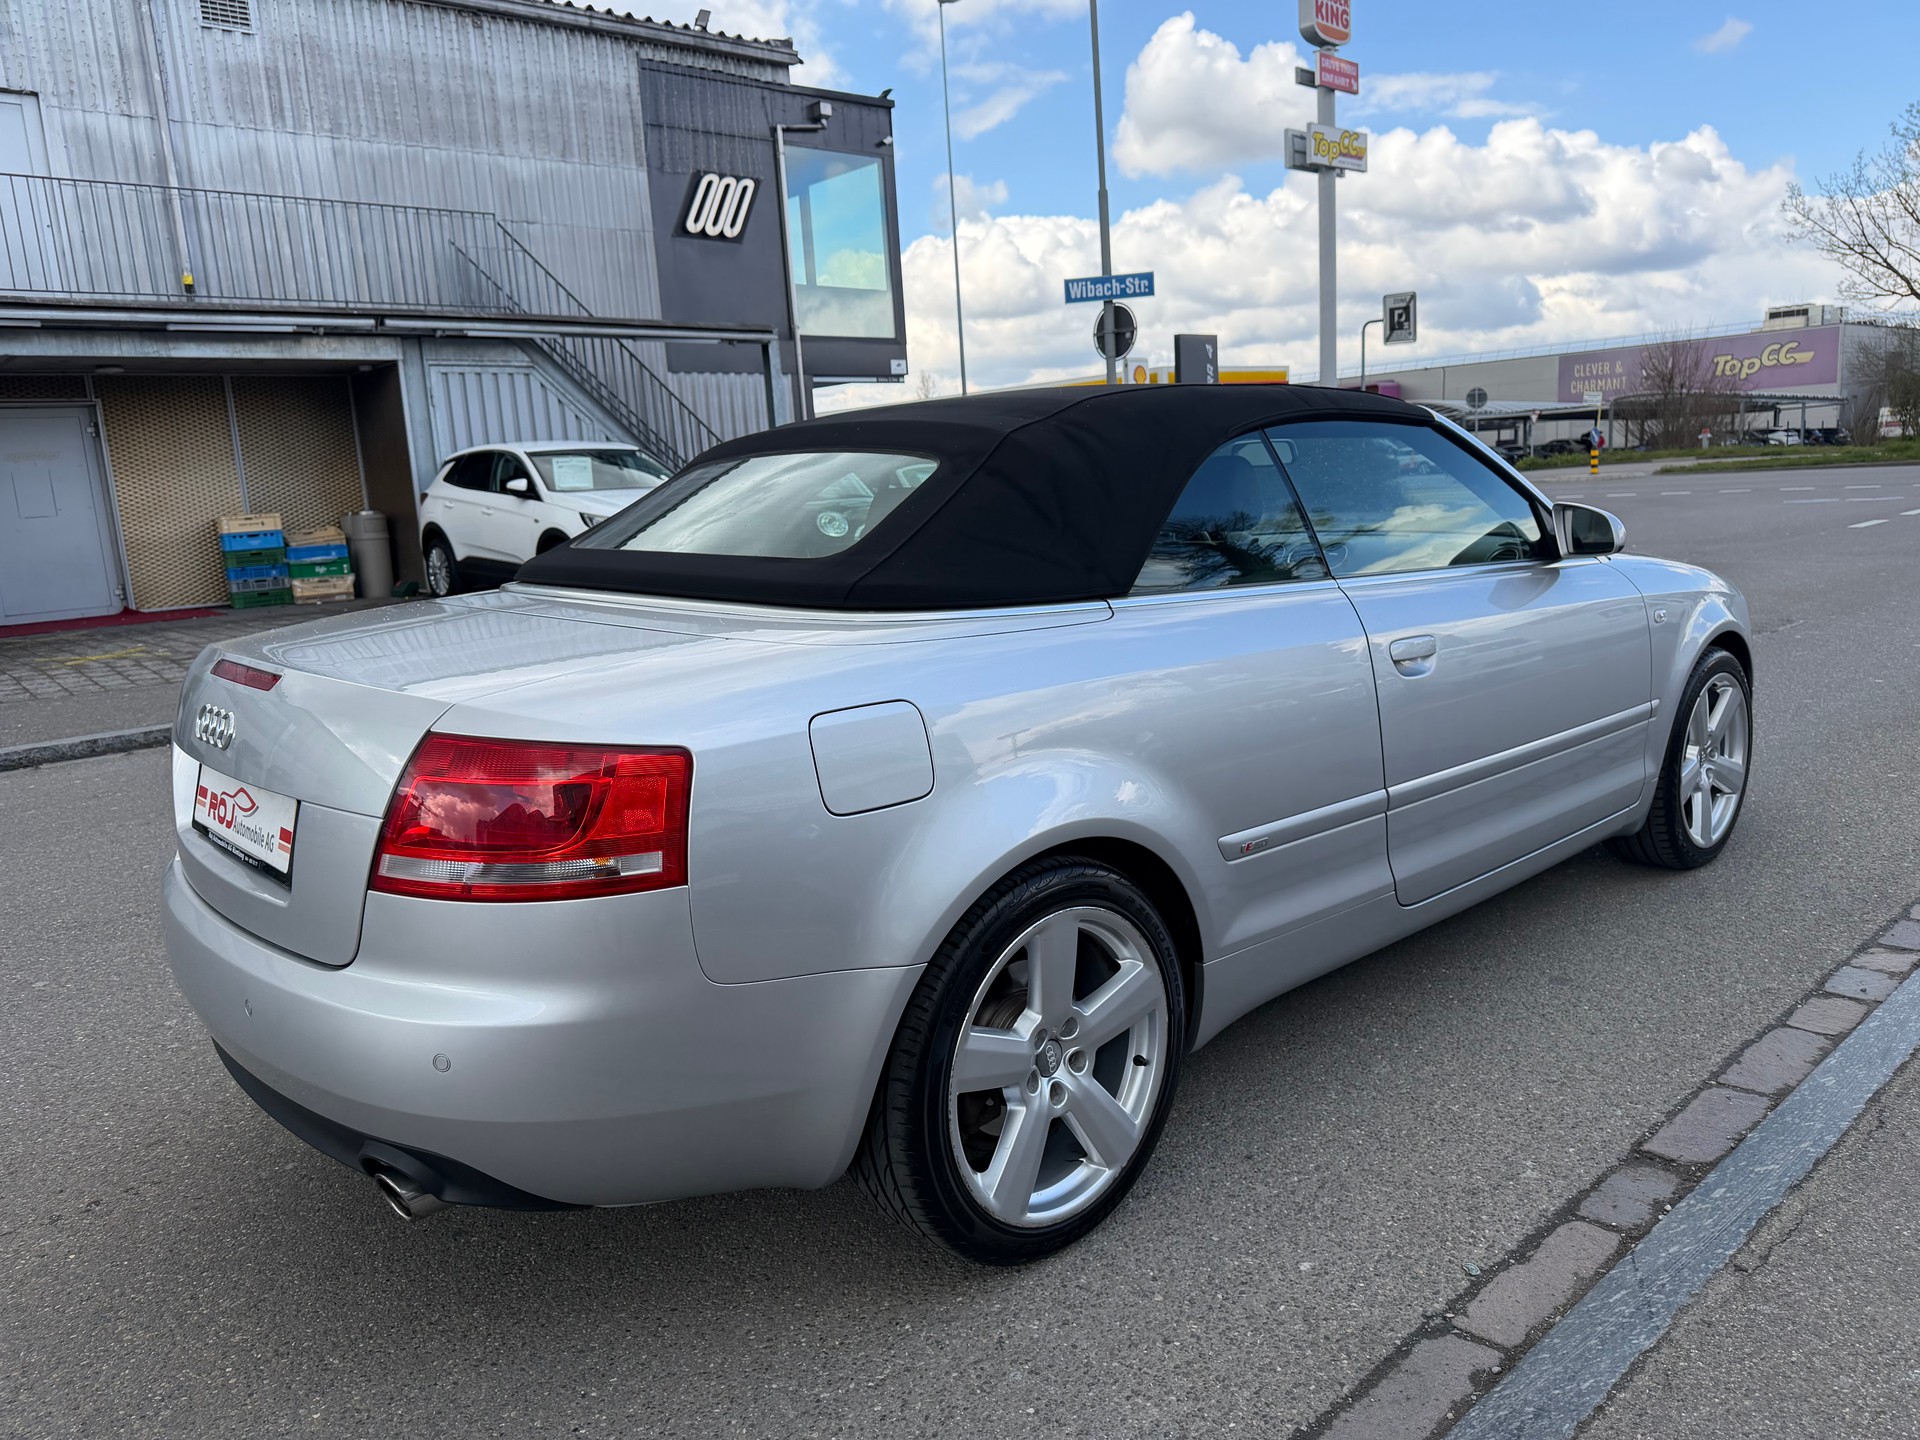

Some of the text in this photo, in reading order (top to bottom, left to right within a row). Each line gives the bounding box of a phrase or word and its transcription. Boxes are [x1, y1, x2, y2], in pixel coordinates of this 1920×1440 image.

[1315, 0, 1349, 30] KING
[1312, 130, 1359, 166] TopCC
[1068, 277, 1149, 299] Wibach-Str.
[1574, 359, 1623, 378] CLEVER &
[1713, 341, 1801, 380] TopCC
[1571, 376, 1627, 394] CHARMANT
[232, 815, 275, 853] Automobile AG
